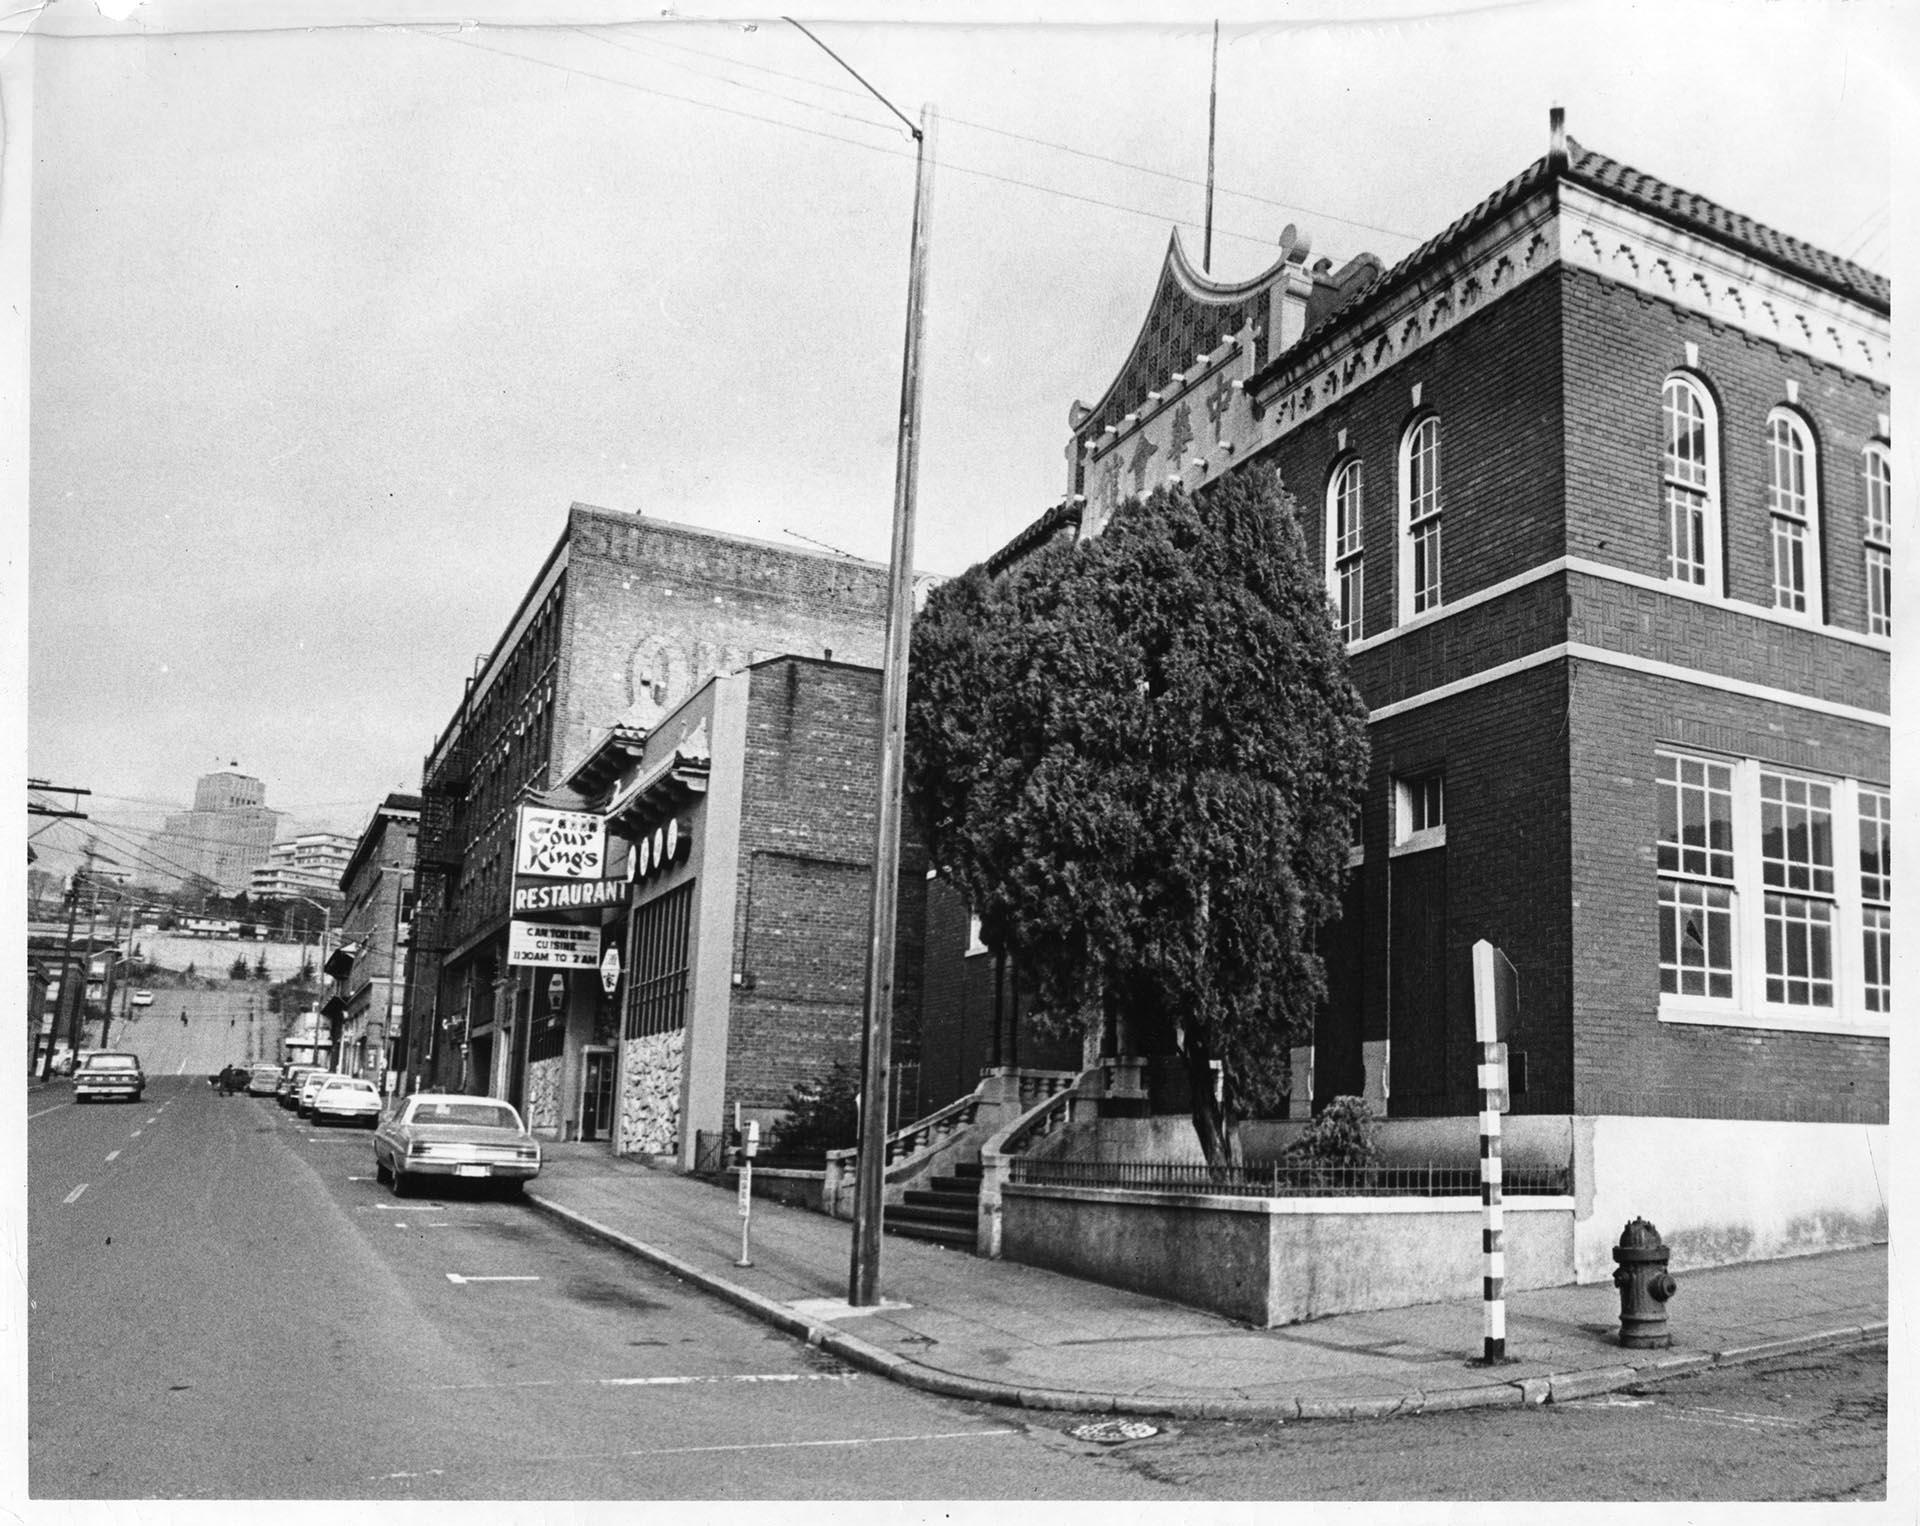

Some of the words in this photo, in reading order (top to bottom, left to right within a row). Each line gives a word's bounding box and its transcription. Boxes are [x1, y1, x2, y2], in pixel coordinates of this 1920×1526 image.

[528, 817, 593, 846] Four
[515, 881, 626, 910] RESTAURANT
[536, 940, 577, 952] CUISINE
[555, 953, 567, 962] TO
